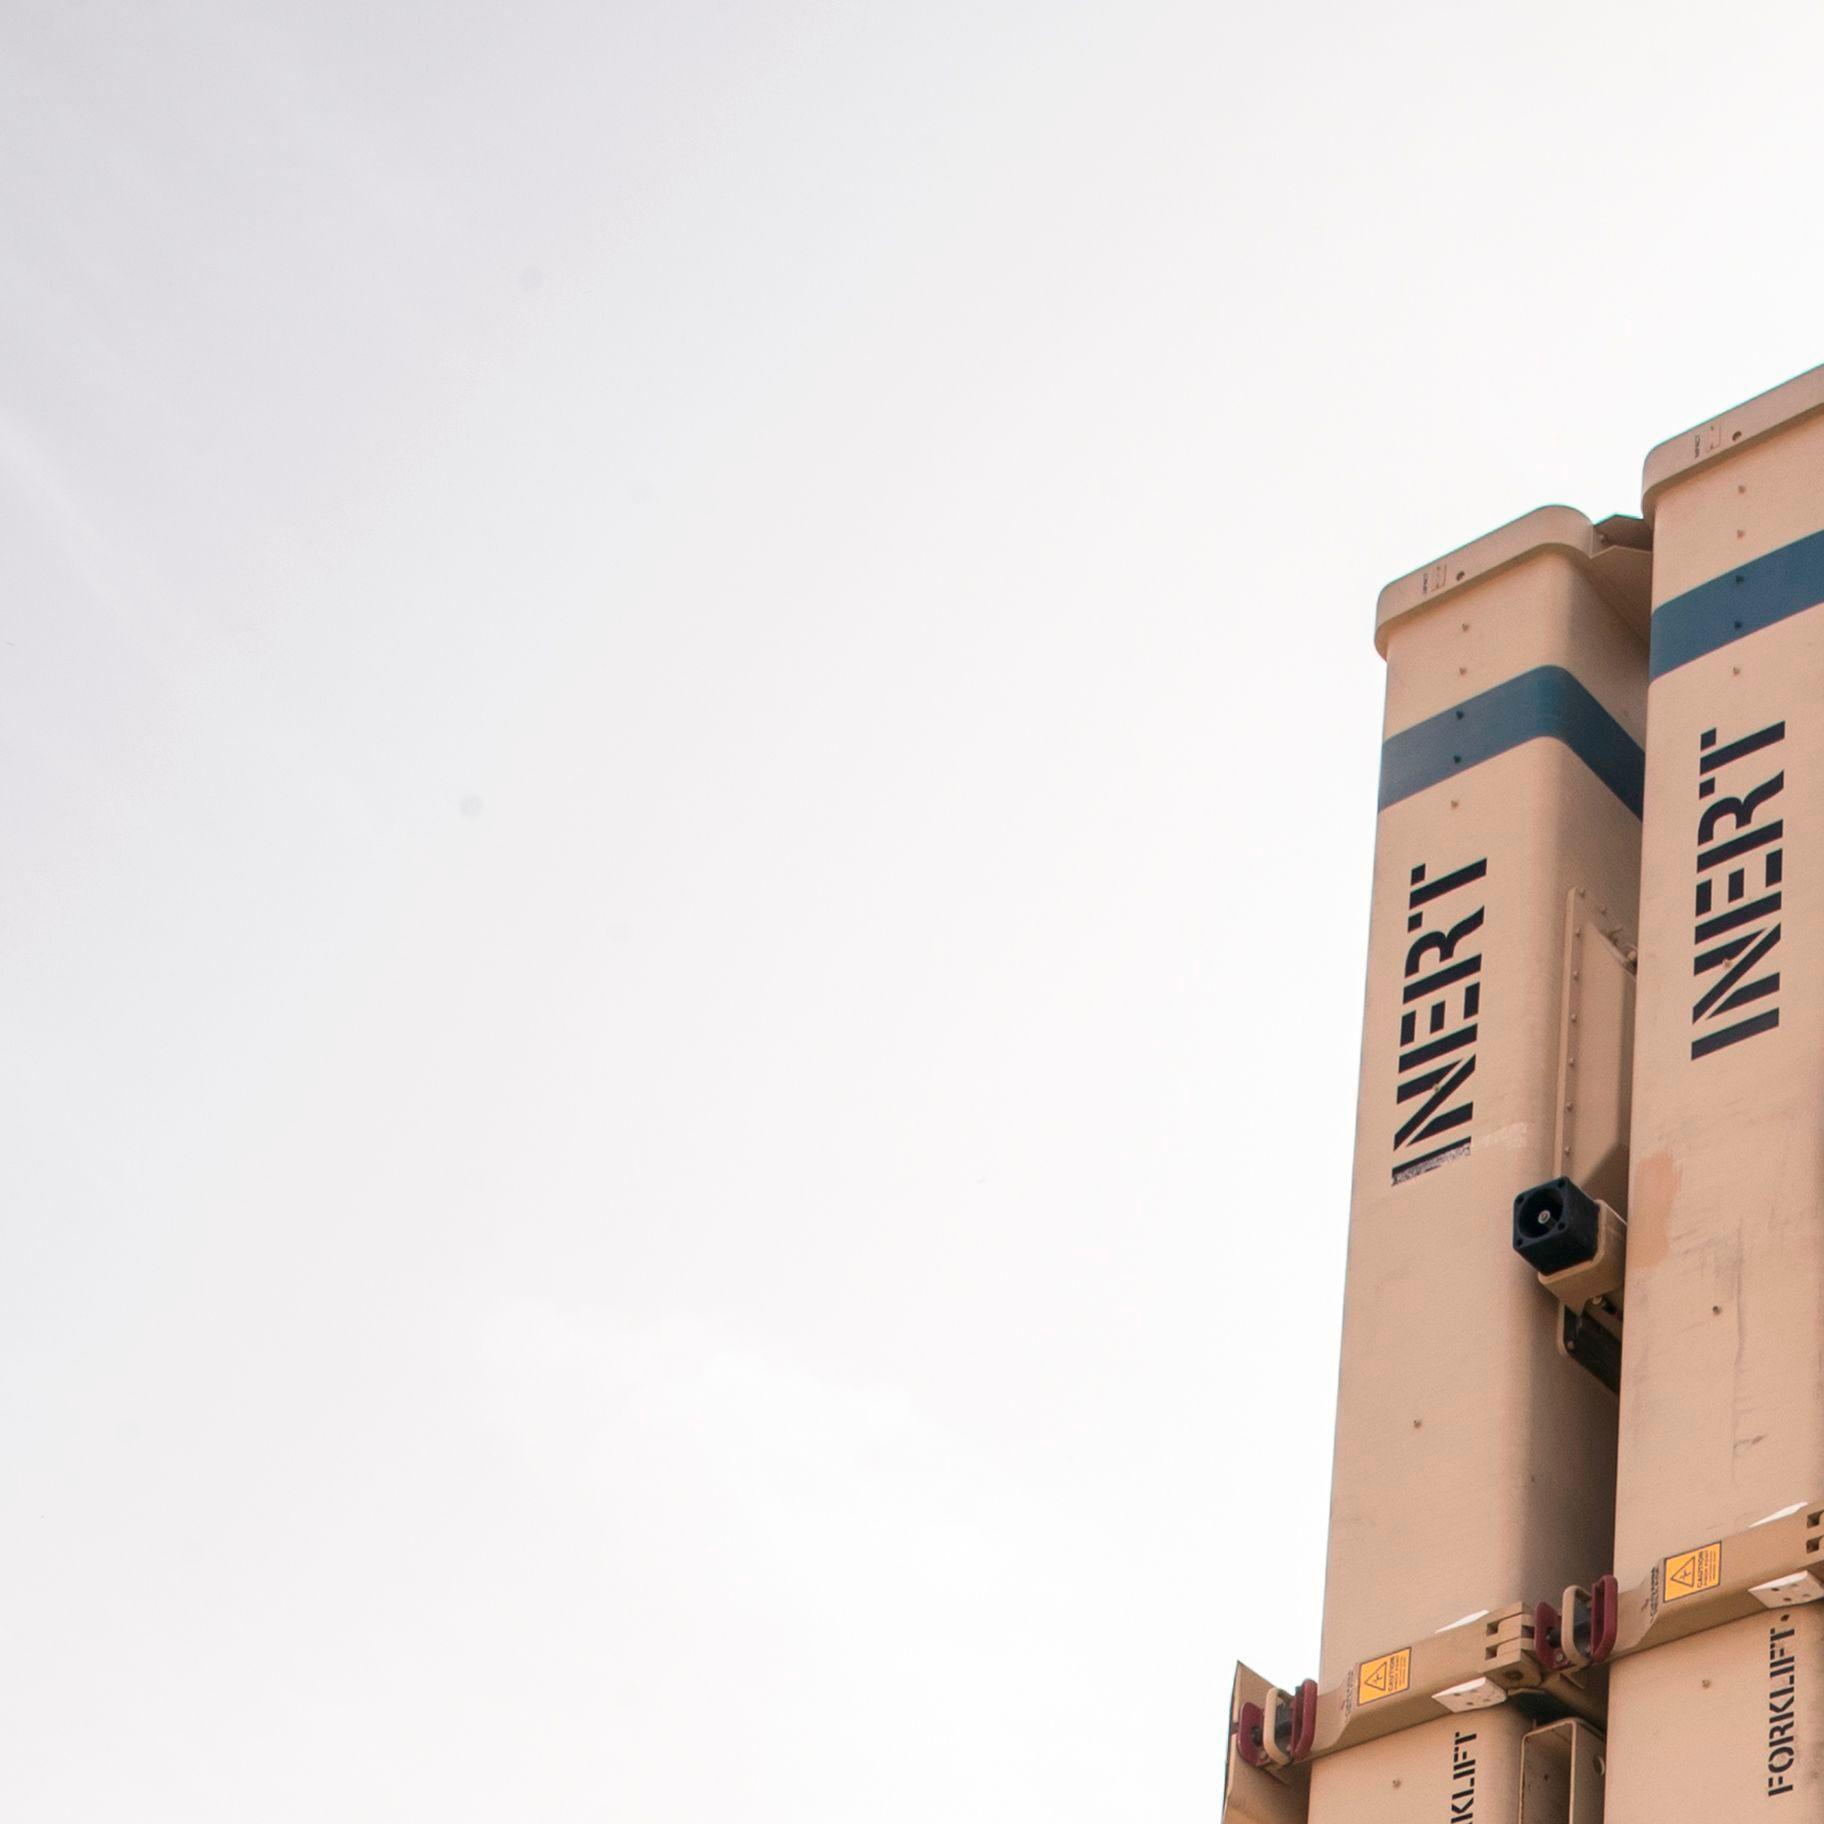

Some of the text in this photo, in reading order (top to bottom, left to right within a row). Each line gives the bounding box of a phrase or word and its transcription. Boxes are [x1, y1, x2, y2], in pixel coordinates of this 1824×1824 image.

[1391, 858, 1487, 1186] INERT
[1691, 721, 1785, 1060] INERT
[1768, 1625, 1795, 1797] FORKLIFT
